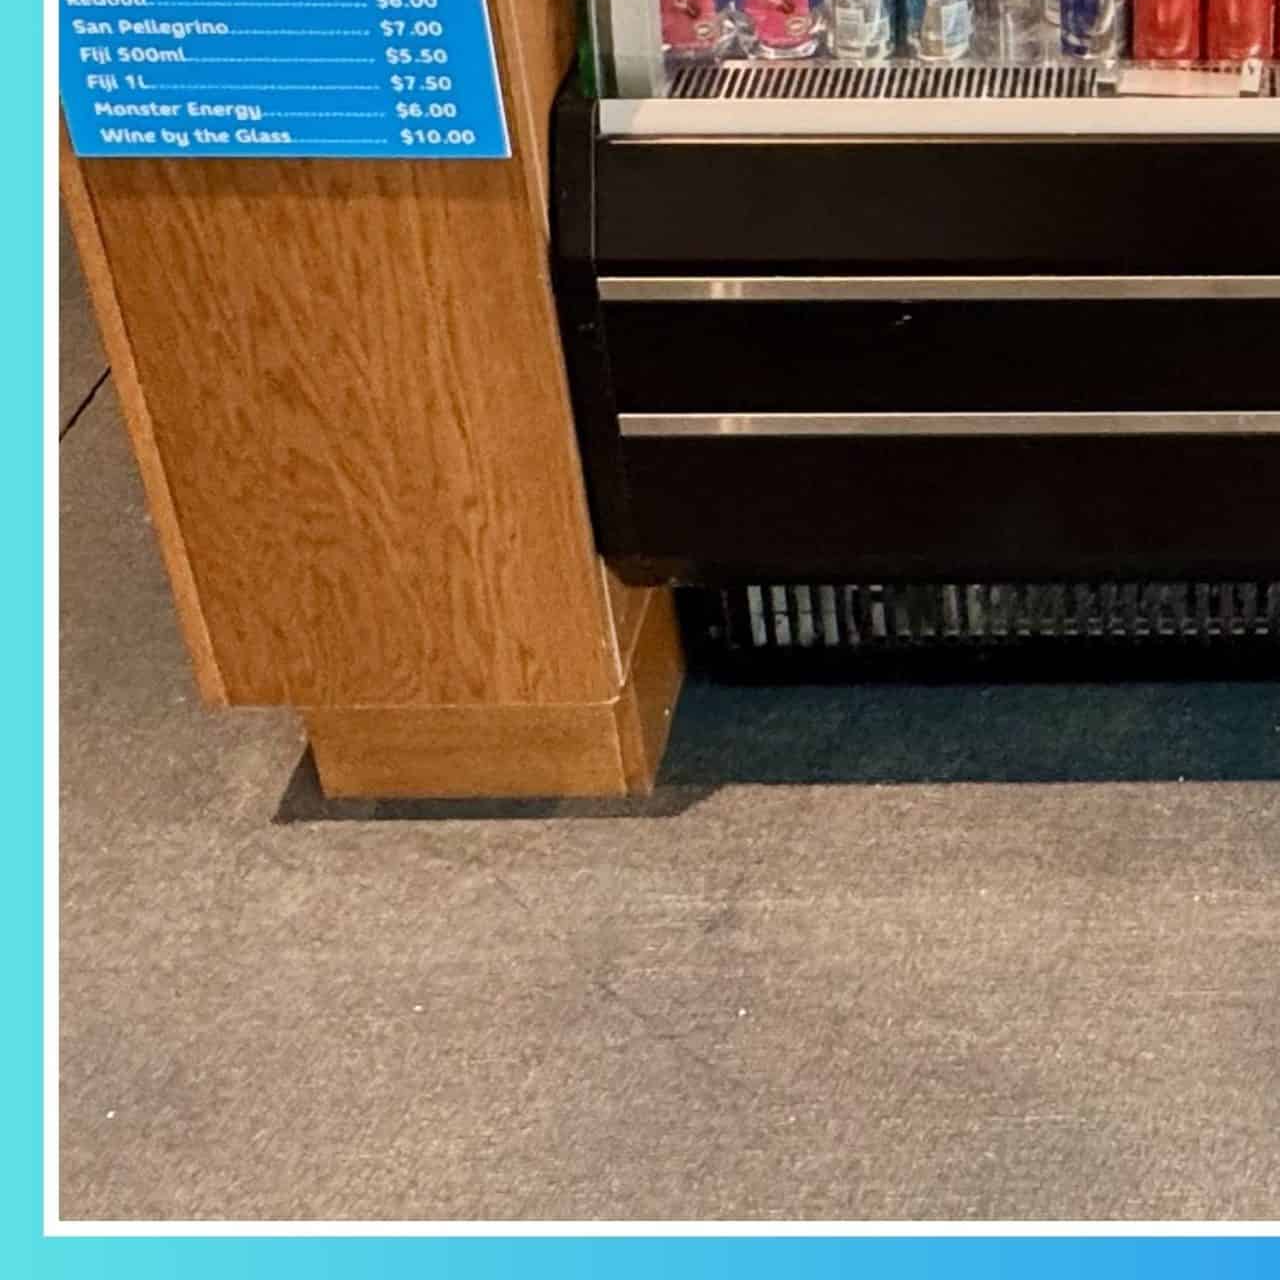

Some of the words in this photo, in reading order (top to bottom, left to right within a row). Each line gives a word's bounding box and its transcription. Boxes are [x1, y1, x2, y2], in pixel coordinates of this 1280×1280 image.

[72, 19, 113, 34] San
[118, 19, 229, 39] Pellegrino
[380, 19, 443, 37] $7.00
[79, 47, 112, 65] Fiji
[117, 47, 187, 62] 500ml
[385, 47, 448, 65] $5.50
[87, 74, 118, 92] Fiji
[125, 75, 149, 89] 1L
[390, 74, 452, 91] $7.50
[94, 102, 180, 116] Monster
[187, 101, 262, 121] Energy
[396, 102, 457, 119] $6.00
[100, 128, 155, 143] Wine
[161, 129, 190, 147] by
[193, 128, 230, 143] the
[235, 129, 292, 144] Glass
[400, 128, 475, 145] $10.00
